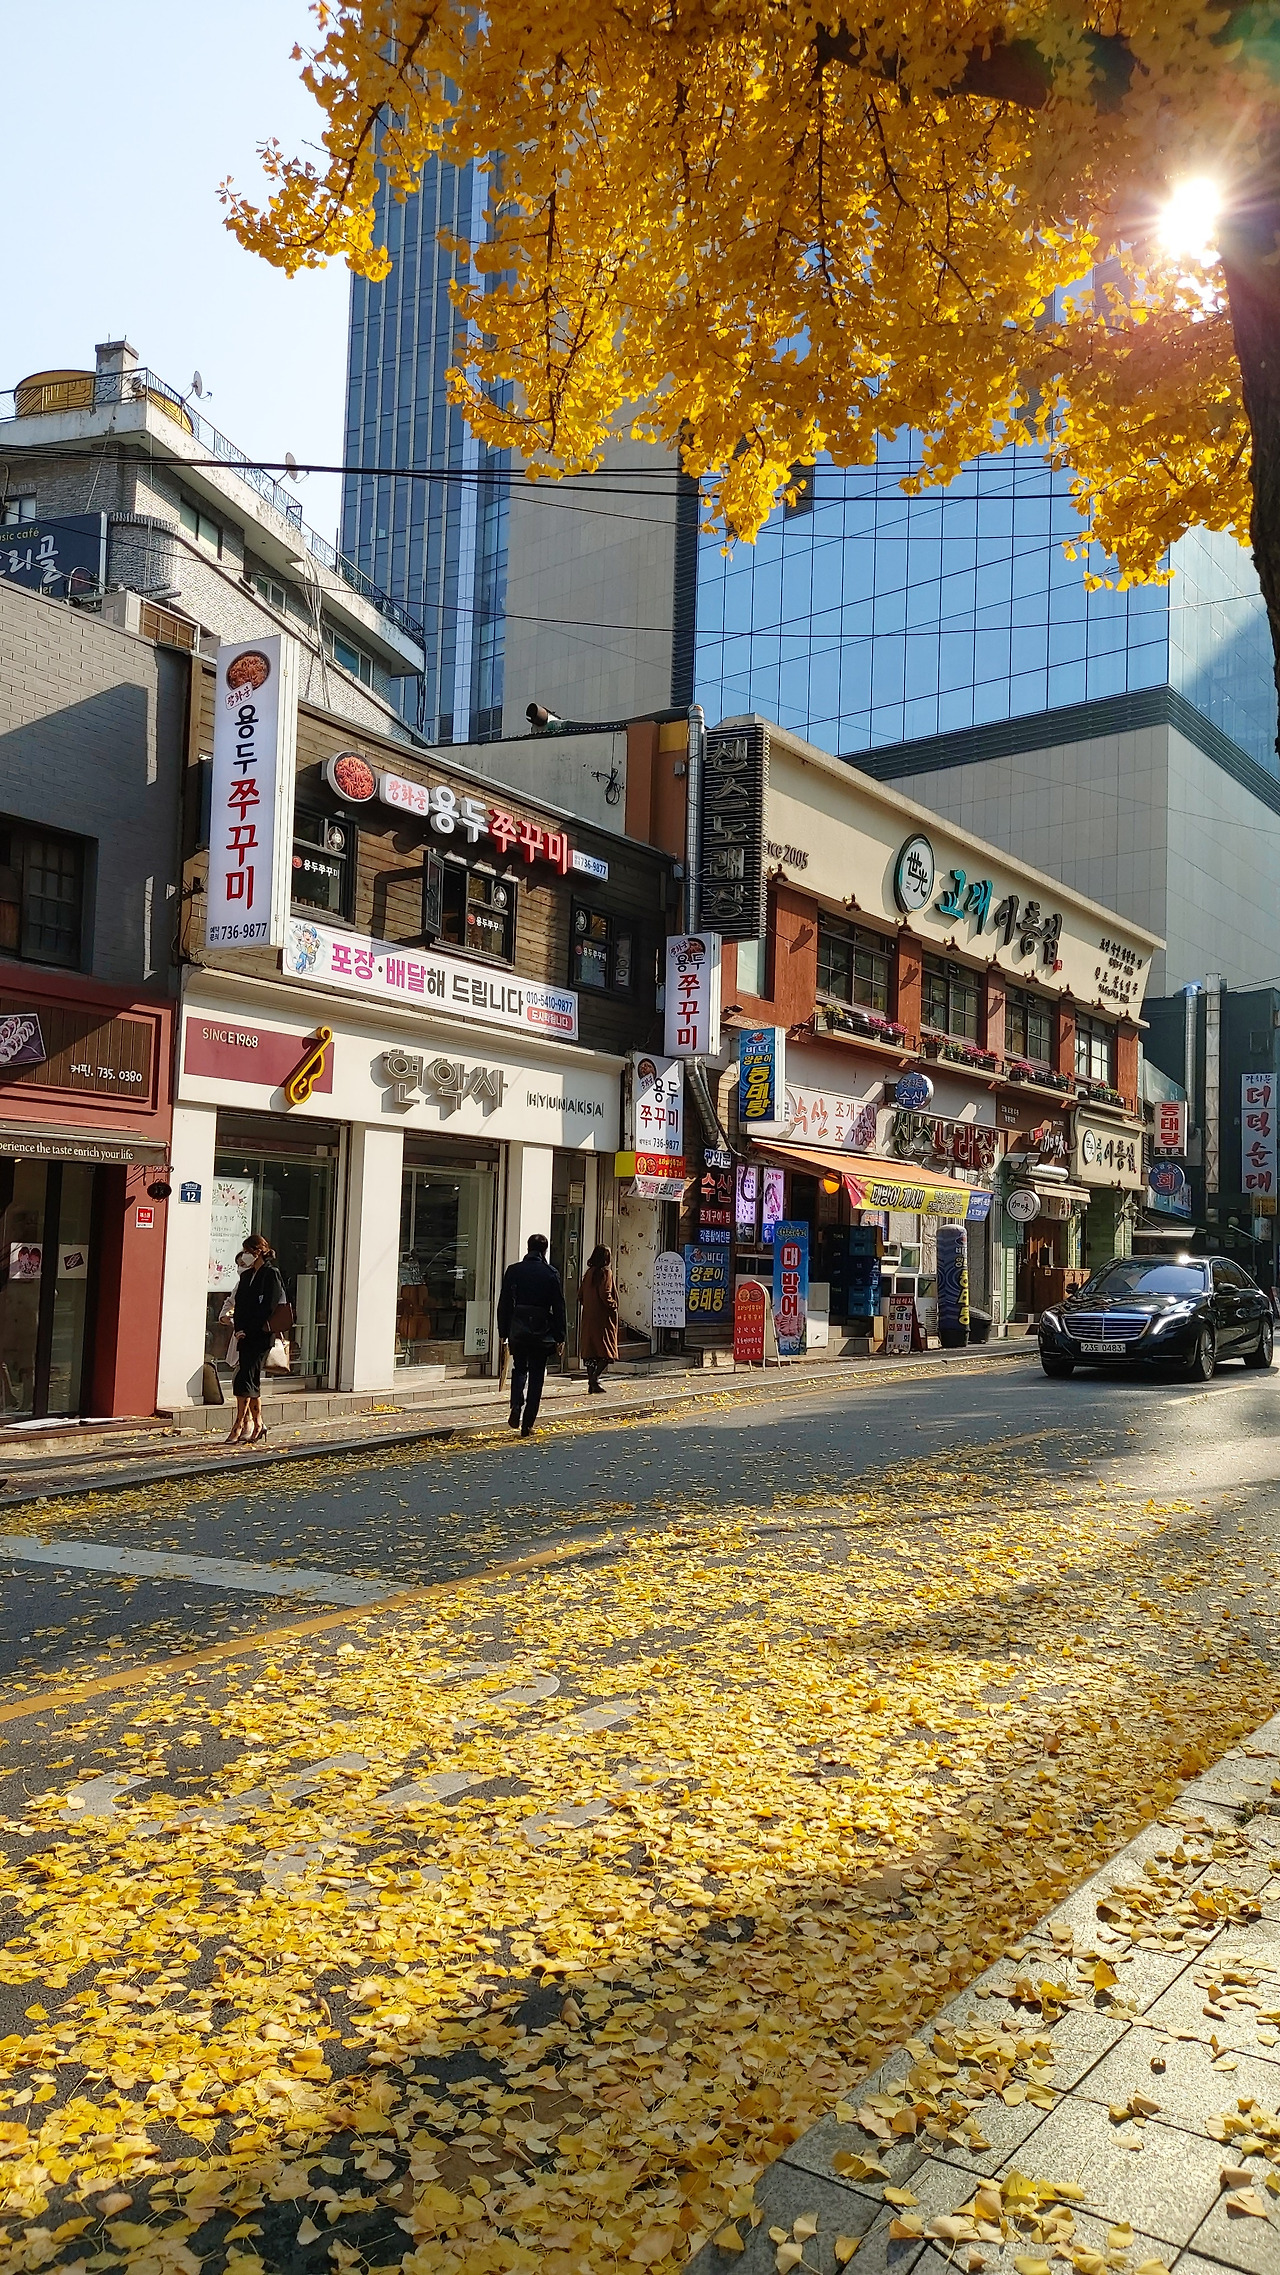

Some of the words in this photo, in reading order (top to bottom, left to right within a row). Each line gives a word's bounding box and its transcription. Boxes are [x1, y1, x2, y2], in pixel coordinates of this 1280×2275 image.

[0, 532, 14, 541] sic
[17, 527, 39, 540] café
[225, 704, 260, 910] 용두쭈꾸미
[429, 786, 568, 874] 용두쭈꾸미
[710, 738, 750, 918] 센스노래장
[580, 857, 607, 875] 736-9877
[783, 844, 809, 869] 2005
[304, 859, 340, 880] 용두쭈꾸미
[221, 922, 268, 941] 736-9877
[675, 952, 705, 972] 용두
[452, 973, 523, 1016] 드립니다
[677, 974, 700, 1050] 쭈꾸미
[745, 1044, 769, 1054] 바다
[118, 1071, 142, 1082] 0380
[383, 1049, 508, 1110] 현악사
[653, 1077, 679, 1104] 용두
[745, 1065, 771, 1118] 동태탕
[899, 1091, 924, 1105] 수산
[639, 1104, 679, 1133] 쭈꾸미
[794, 1096, 829, 1139] 수산
[1160, 1103, 1181, 1146] 동태탕
[36, 1142, 51, 1154] the
[52, 1145, 73, 1155] taste
[73, 1146, 100, 1158] enrich
[100, 1150, 120, 1160] your
[120, 1149, 134, 1160] life
[652, 1138, 680, 1150] 736-9877
[1245, 1085, 1273, 1193] 더덕순대
[704, 1148, 731, 1169] 광화문
[186, 1191, 196, 1202] 12
[701, 1172, 733, 1203] 수산
[870, 1184, 901, 1206] 대방어
[900, 1188, 926, 1209] 개시!!
[707, 1252, 724, 1264] 바다
[781, 1247, 800, 1317] 대방어
[689, 1288, 726, 1311] 동태탕
[1102, 1344, 1122, 1352] 0483
